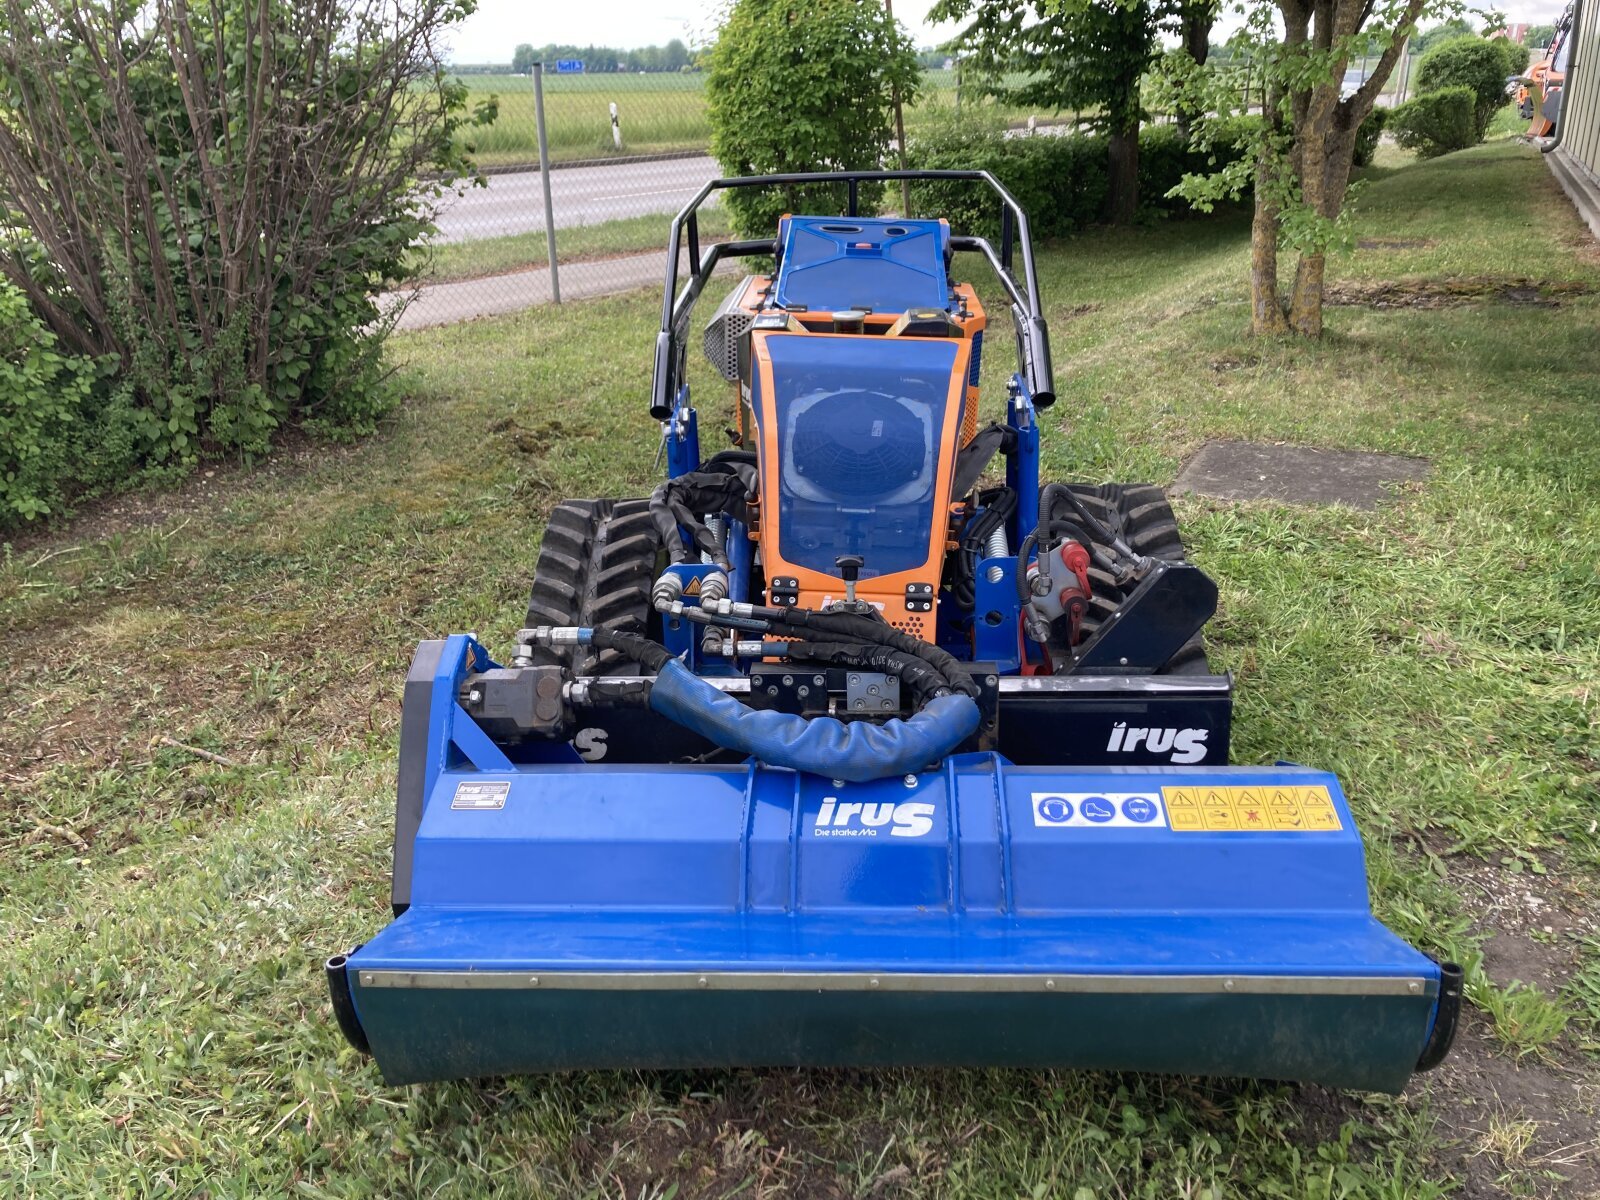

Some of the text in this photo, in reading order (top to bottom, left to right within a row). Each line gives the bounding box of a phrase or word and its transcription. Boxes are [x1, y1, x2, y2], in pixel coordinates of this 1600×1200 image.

[1106, 721, 1209, 764] irus
[815, 797, 935, 836] irus
[815, 828, 830, 837] Die
[832, 828, 858, 837] starke
